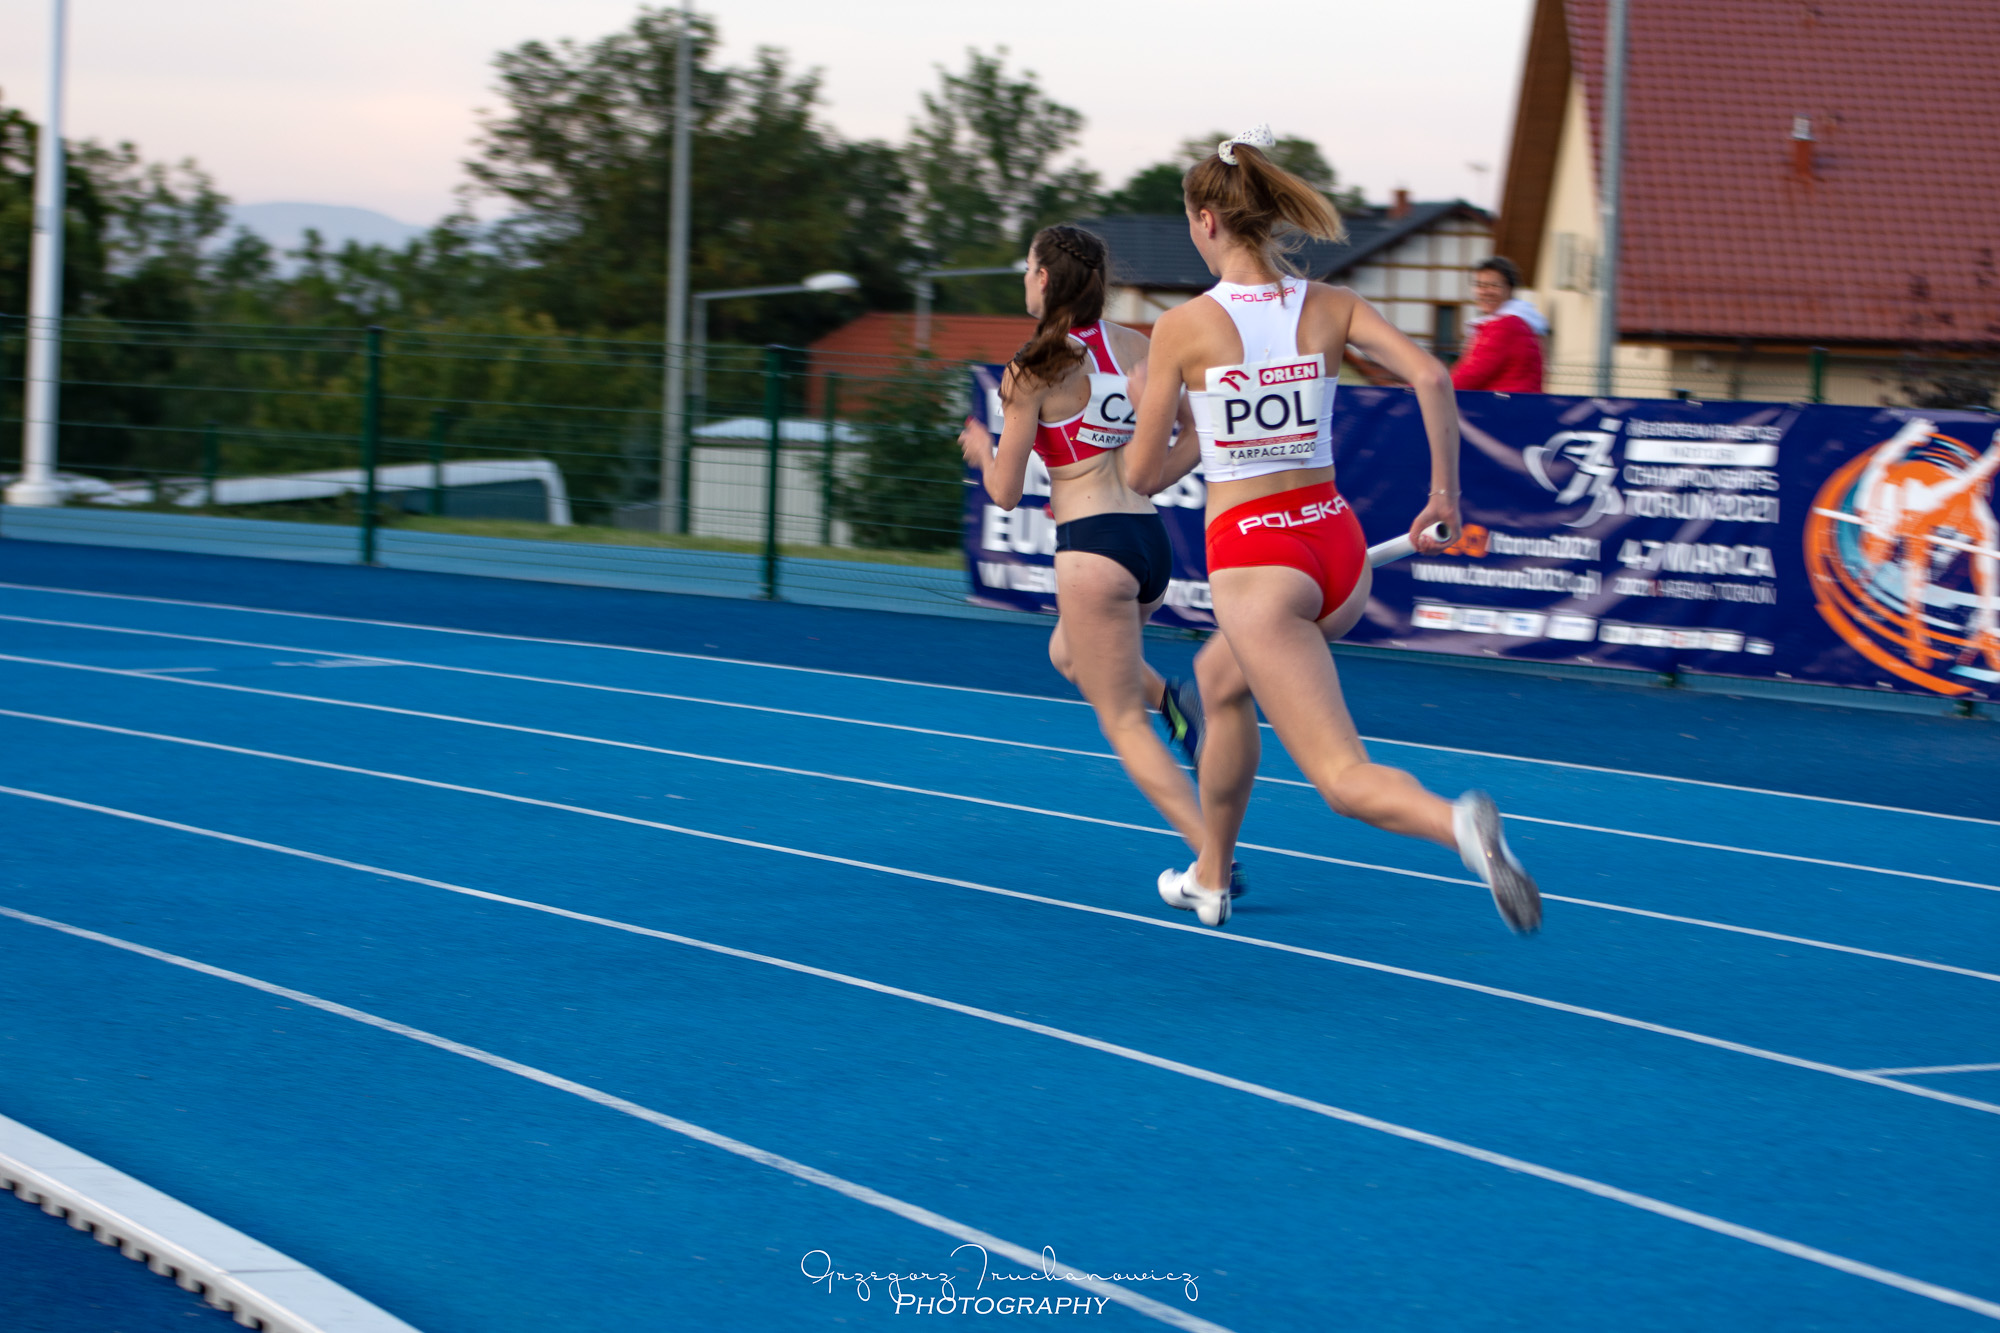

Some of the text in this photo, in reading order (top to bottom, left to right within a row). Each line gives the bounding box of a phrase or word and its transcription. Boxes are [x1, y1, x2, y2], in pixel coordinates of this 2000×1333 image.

[1230, 286, 1297, 303] POLSKA
[1261, 364, 1316, 384] ORLEN
[1224, 390, 1317, 435] POL
[1229, 442, 1316, 460] KARPACZ 2020
[1237, 496, 1349, 535] POLSKA
